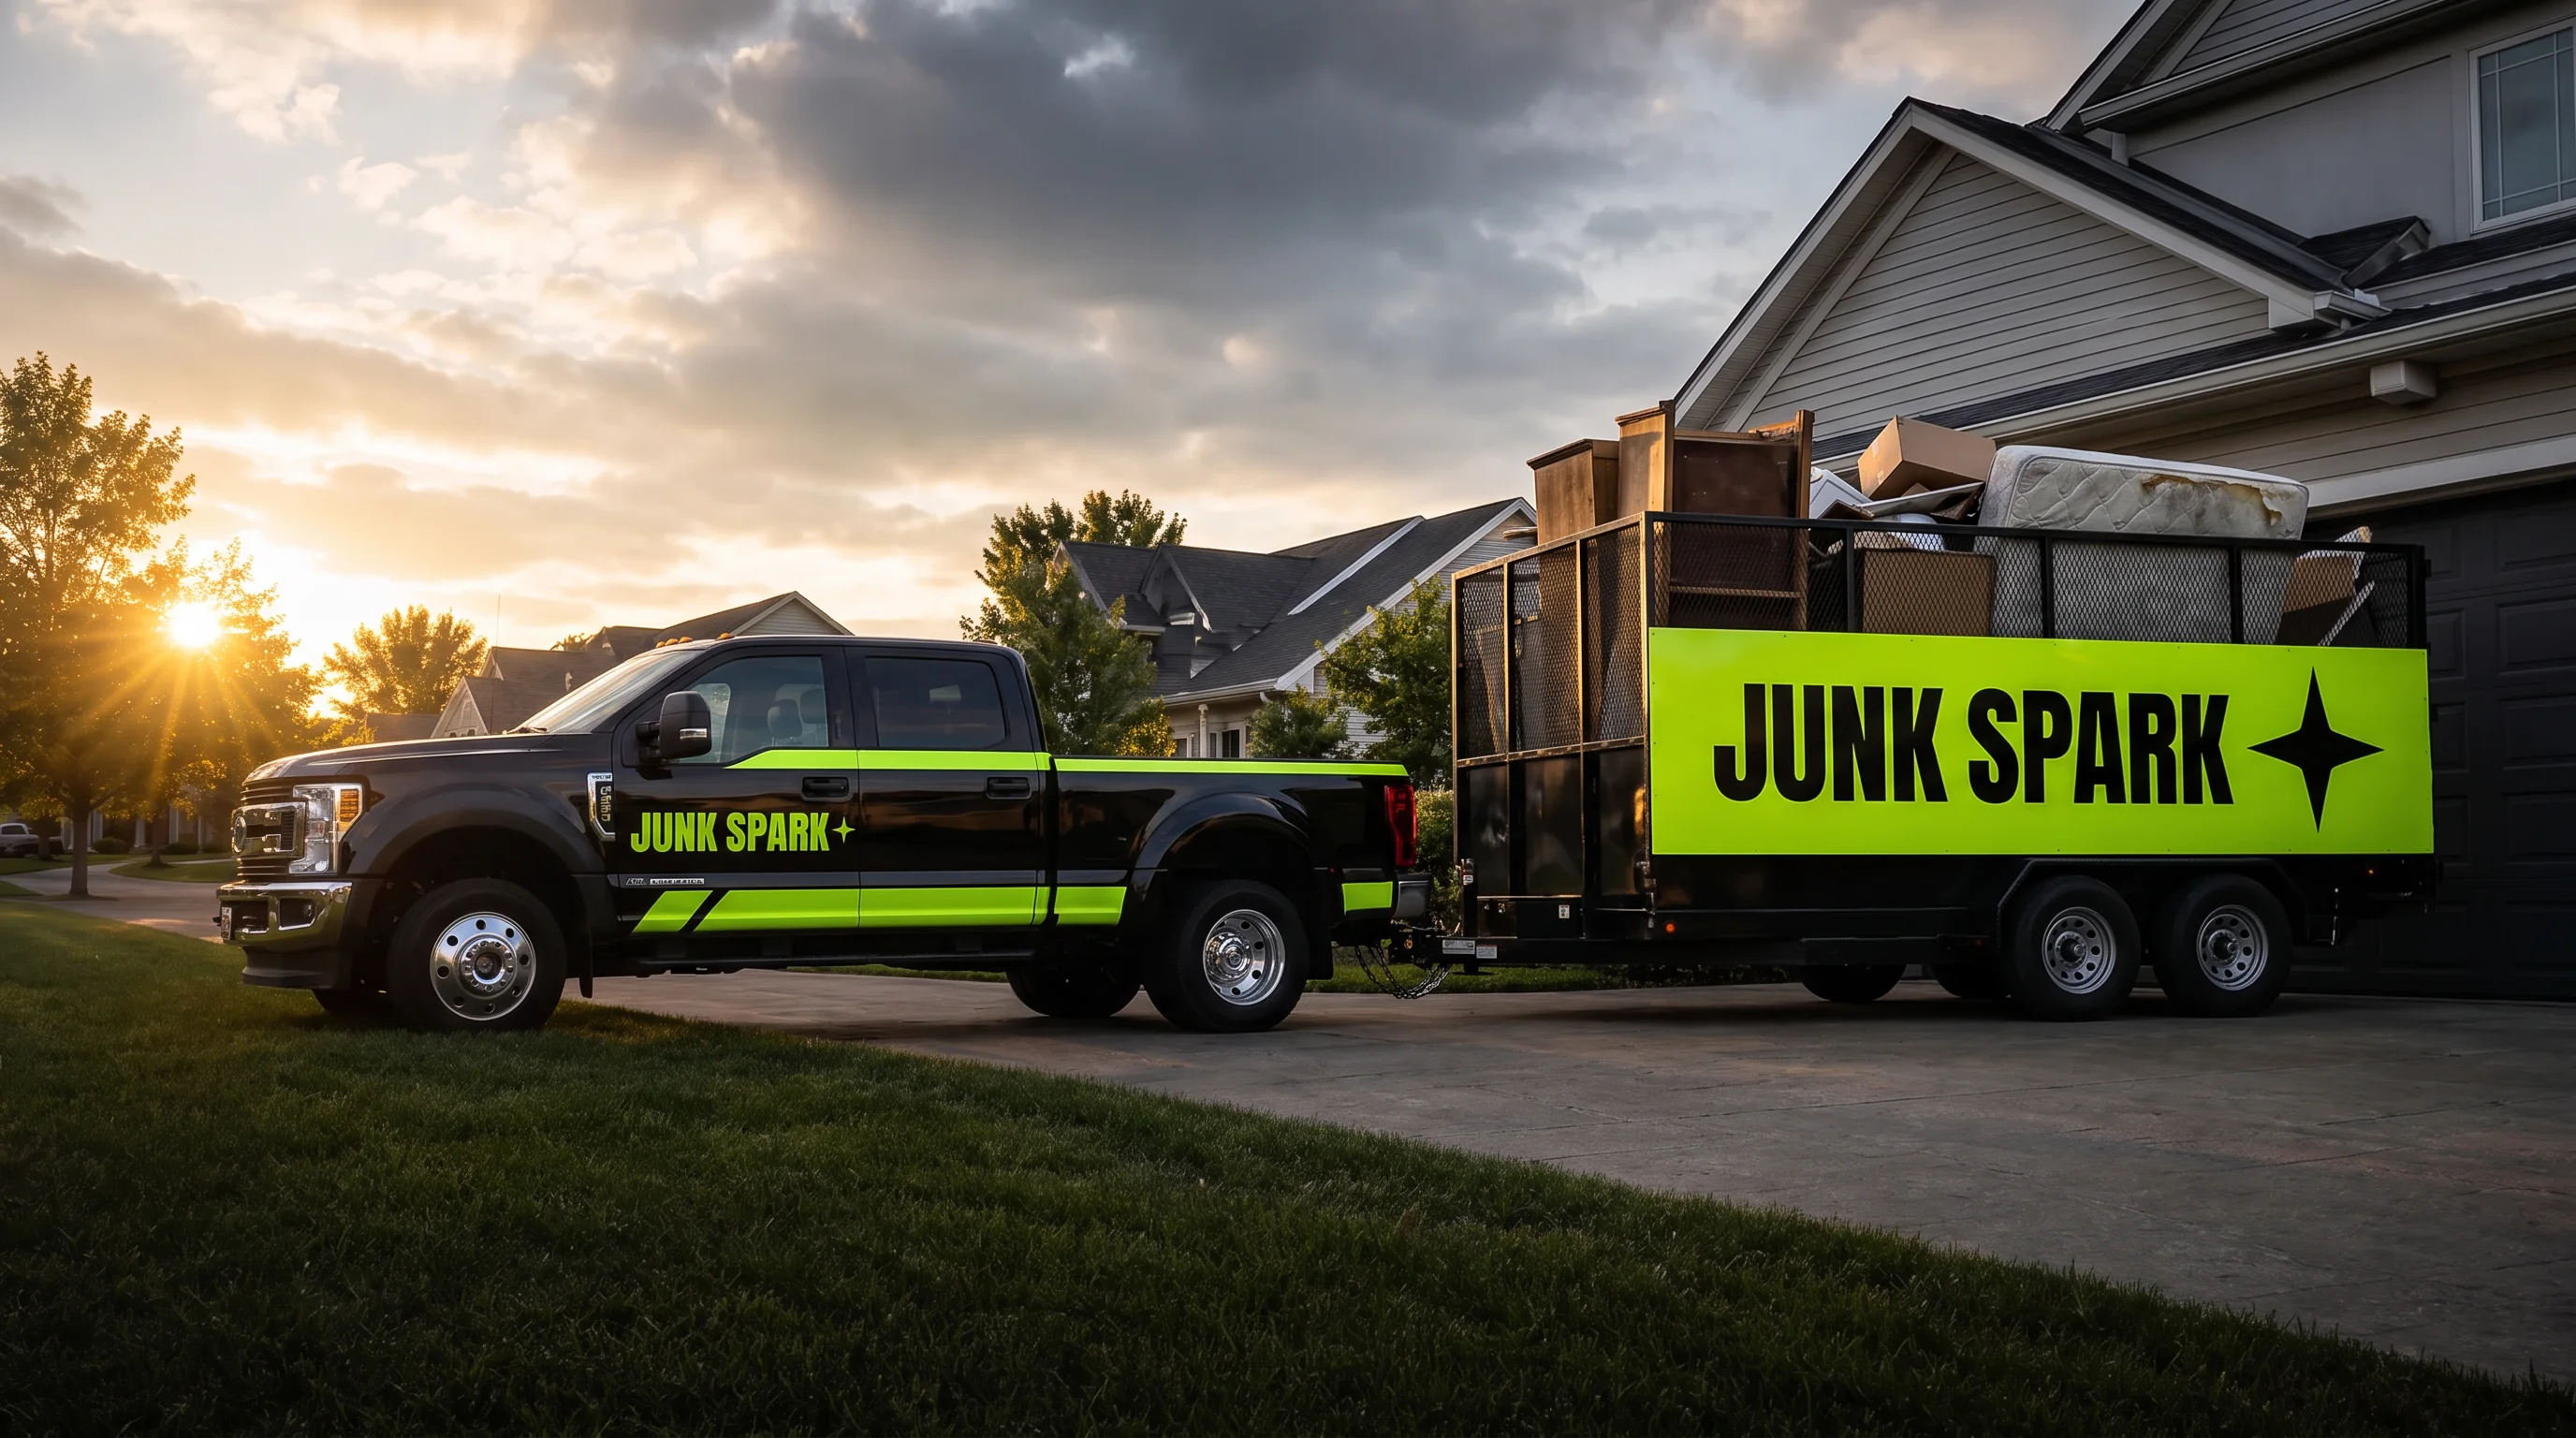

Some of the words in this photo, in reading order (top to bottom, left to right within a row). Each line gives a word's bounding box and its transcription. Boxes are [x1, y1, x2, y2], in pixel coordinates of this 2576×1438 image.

[1713, 682, 1949, 802] JUNK
[1967, 687, 2234, 805] SPARK
[630, 812, 718, 853] JUNK
[725, 812, 830, 853] SPARK
